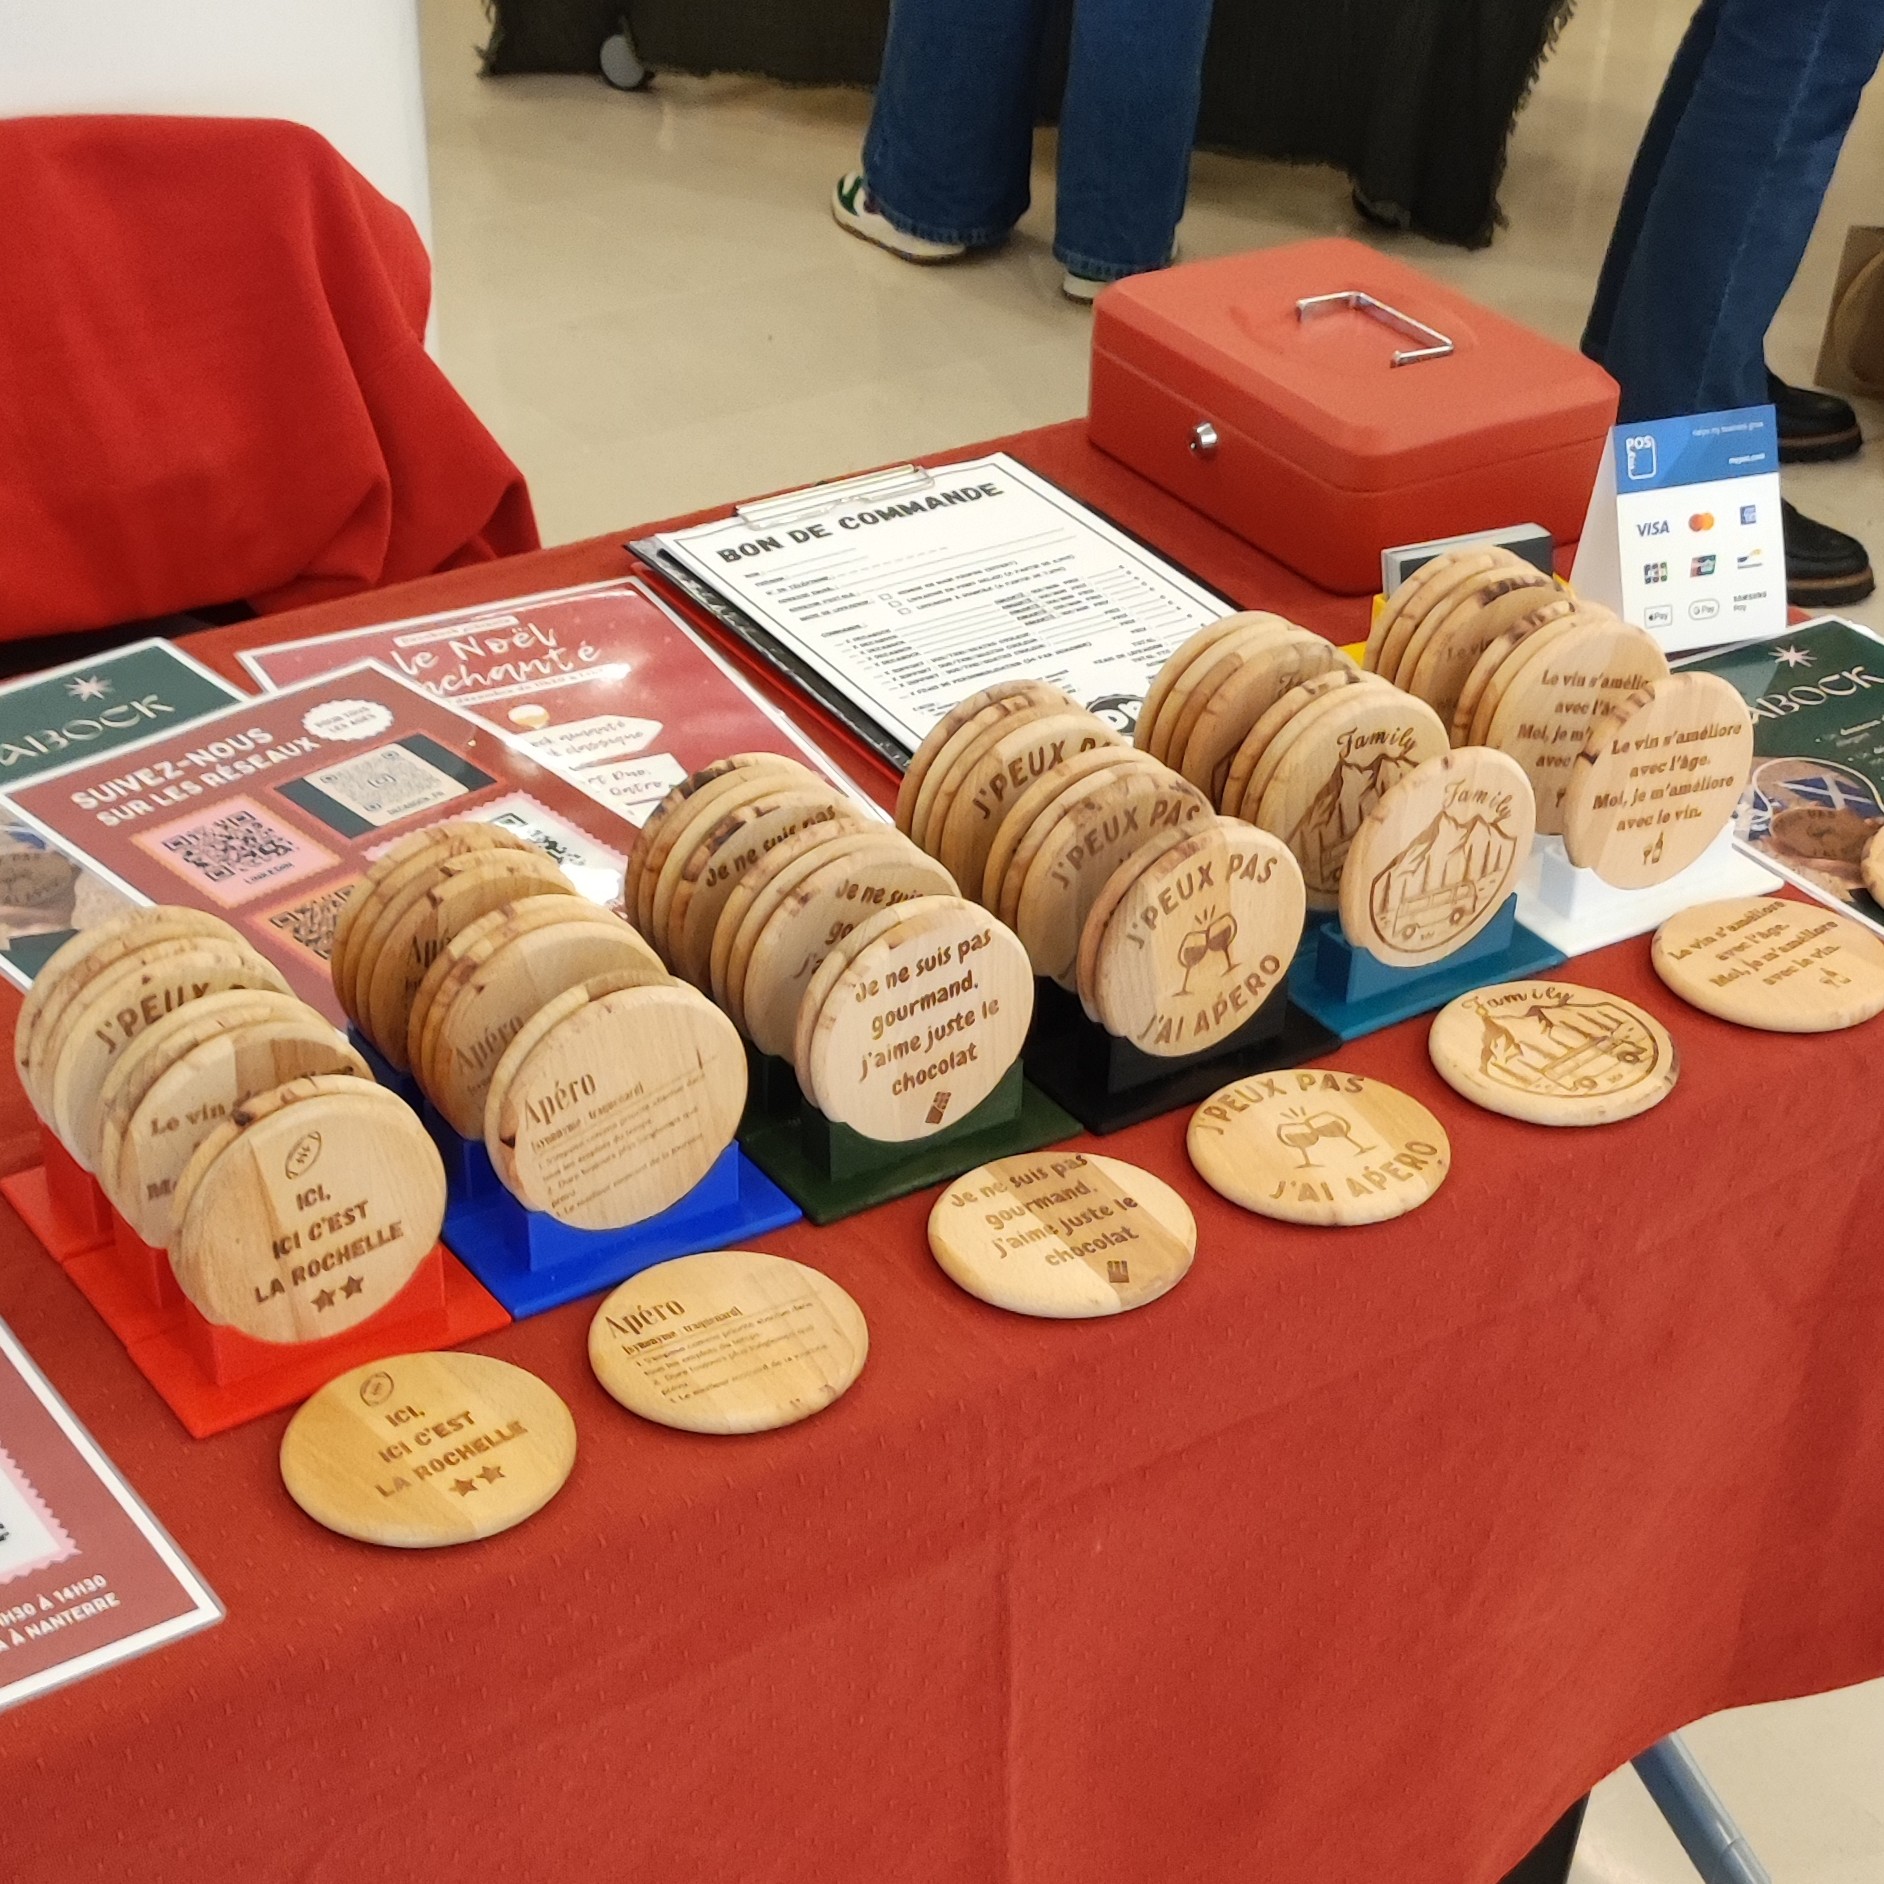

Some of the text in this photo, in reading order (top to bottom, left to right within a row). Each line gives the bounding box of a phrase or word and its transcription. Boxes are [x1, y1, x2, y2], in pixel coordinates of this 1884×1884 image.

[716, 480, 1005, 563] BON DE COMMANDE
[1636, 519, 1670, 537] VISA
[421, 640, 602, 697] nchanté
[448, 622, 558, 661] Noël
[1554, 701, 1590, 715] avec
[1336, 727, 1420, 759] Family
[1611, 722, 1742, 755] Le vin s'améliore
[70, 727, 274, 811] SUIVEZ-NOUS
[96, 736, 322, 828] SUR LES RÉSEAUX
[971, 739, 1066, 820] J'PEUX
[1629, 762, 1668, 779] avec
[1443, 778, 1514, 818] Family
[1592, 791, 1628, 811] Moi,
[1630, 786, 1647, 804] je
[1616, 803, 1702, 832] avec le vin.
[705, 863, 730, 888] Je
[735, 848, 759, 874] ne
[1050, 798, 1201, 892] J'PEUX PAS
[835, 880, 860, 900] Je
[861, 884, 886, 905] ne
[1126, 852, 1279, 950] J'PEUX PAS
[854, 927, 993, 1004] Je ne suis pas
[871, 969, 979, 1041] gourmand.
[1137, 953, 1282, 1047] J'AI APÉRO
[1461, 986, 1578, 1016] Family
[455, 1014, 524, 1077] Apéro
[858, 997, 1001, 1084] j'aime juste le
[890, 1040, 979, 1097] chocolat
[150, 1116, 180, 1137] Le
[524, 1072, 598, 1132] Apéro
[1196, 1073, 1366, 1137] J'PEUX PAS
[296, 1183, 332, 1212] ICI,
[950, 1154, 1089, 1208] Je ne suis pas
[1268, 1139, 1439, 1203] J'AI APÉRO
[271, 1200, 370, 1261] ICI C'EST
[985, 1178, 1098, 1231] gourmand.
[990, 1195, 1139, 1260] j'aime juste le
[253, 1220, 405, 1304] LA ROCHELLE
[1044, 1225, 1140, 1267] chocolat
[604, 1298, 686, 1339] Apéro
[377, 1410, 477, 1464] ICI C'EST
[385, 1404, 427, 1428] ICI,
[373, 1419, 529, 1499] LA ROCHELLE
[8, 1591, 121, 1647] À NANTERRE
[36, 1593, 56, 1611] À
[52, 1573, 108, 1604] 14H30
